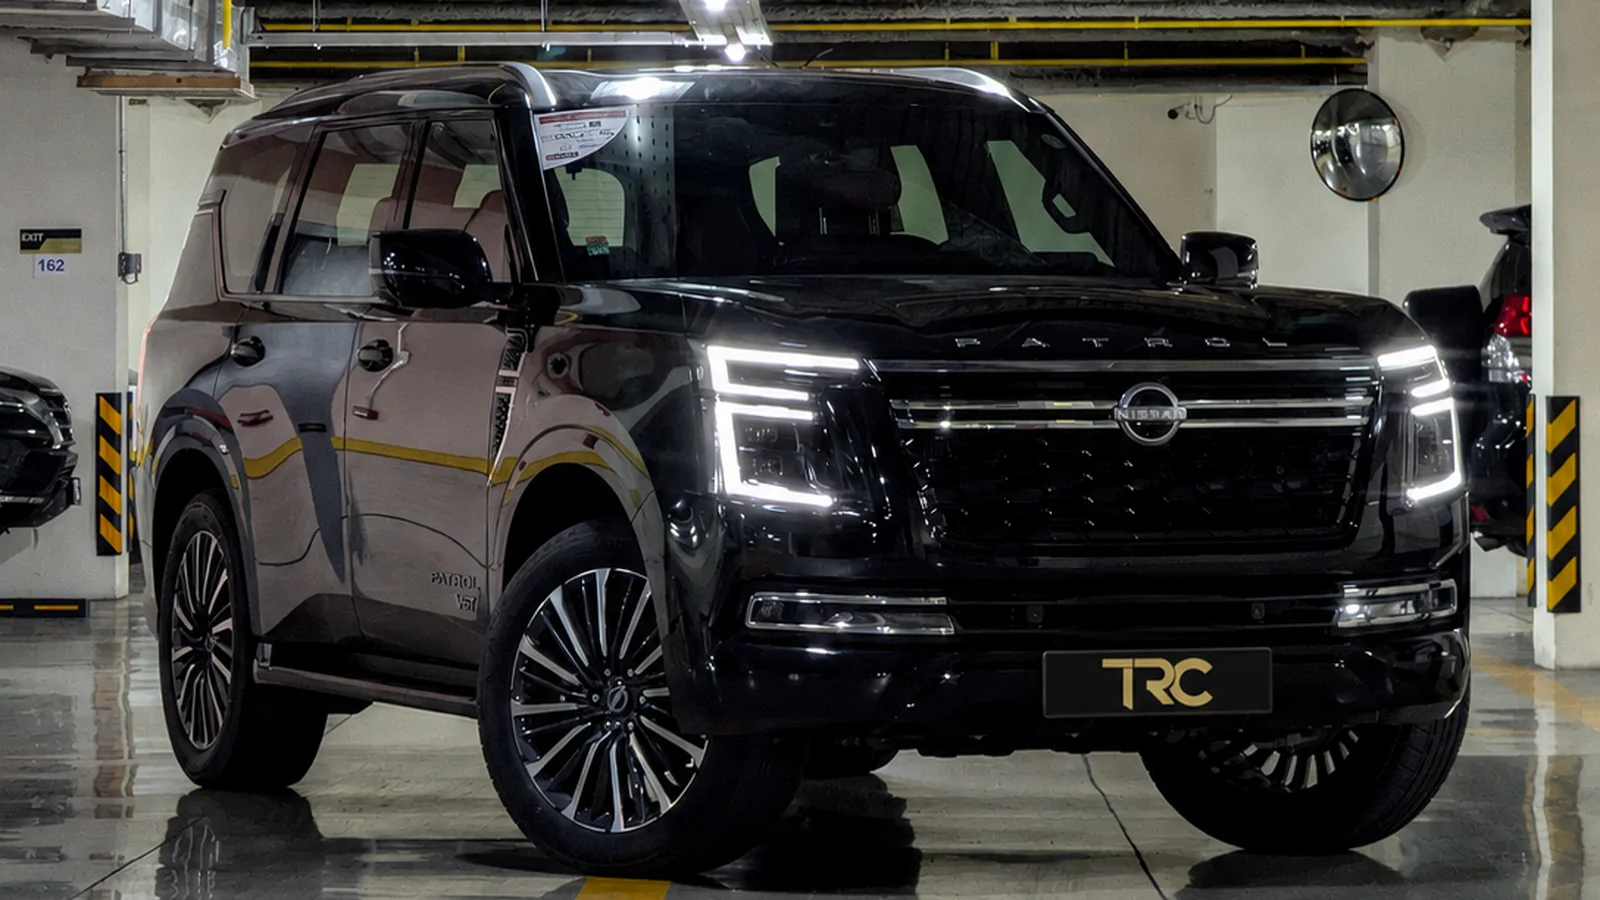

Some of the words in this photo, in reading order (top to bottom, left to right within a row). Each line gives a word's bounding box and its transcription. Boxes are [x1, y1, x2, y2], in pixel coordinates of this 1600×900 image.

[21, 232, 44, 242] EXIT
[38, 258, 65, 272] 162
[954, 337, 1288, 348] PATROL
[1114, 406, 1187, 420] NISSAN
[431, 571, 477, 589] PATROL
[1101, 657, 1213, 710] TRC
